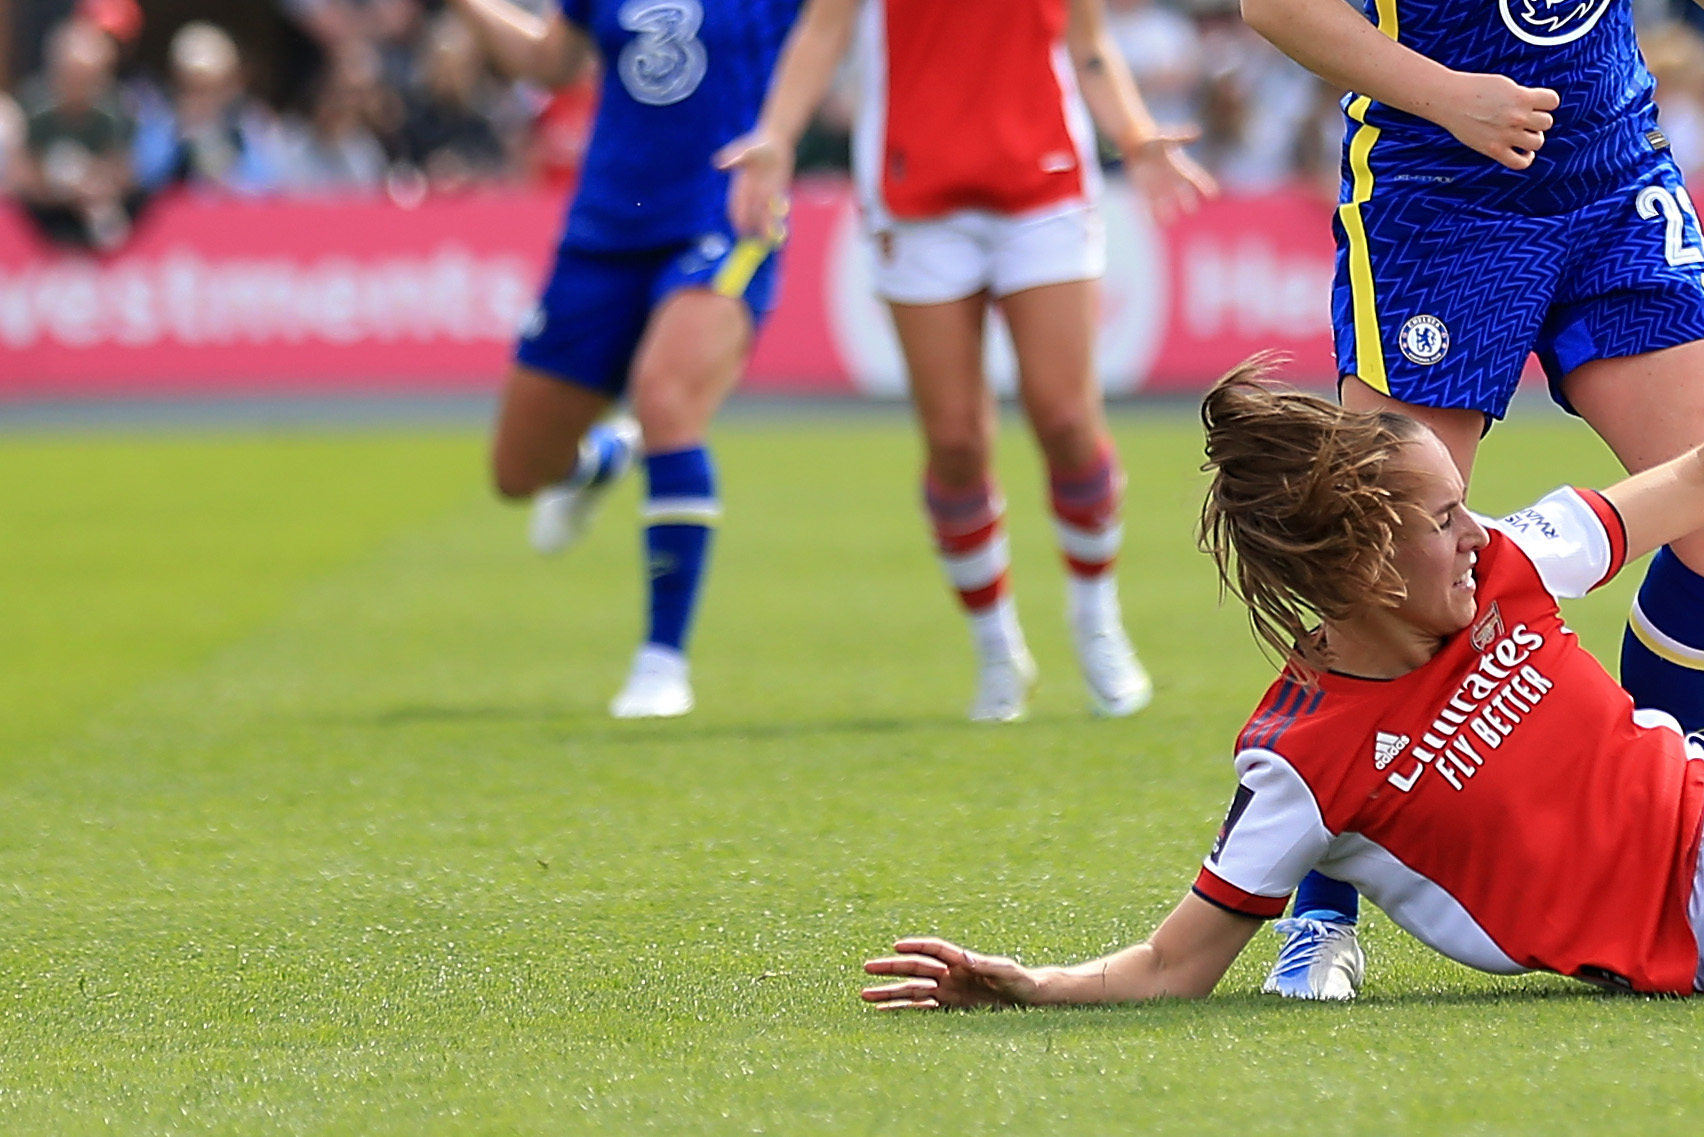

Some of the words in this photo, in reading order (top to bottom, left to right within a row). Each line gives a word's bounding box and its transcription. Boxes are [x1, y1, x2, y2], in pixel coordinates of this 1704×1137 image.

[1375, 735, 1410, 770] adidas
[1435, 734, 1484, 791] FLY
[1469, 664, 1553, 749] BETTER
